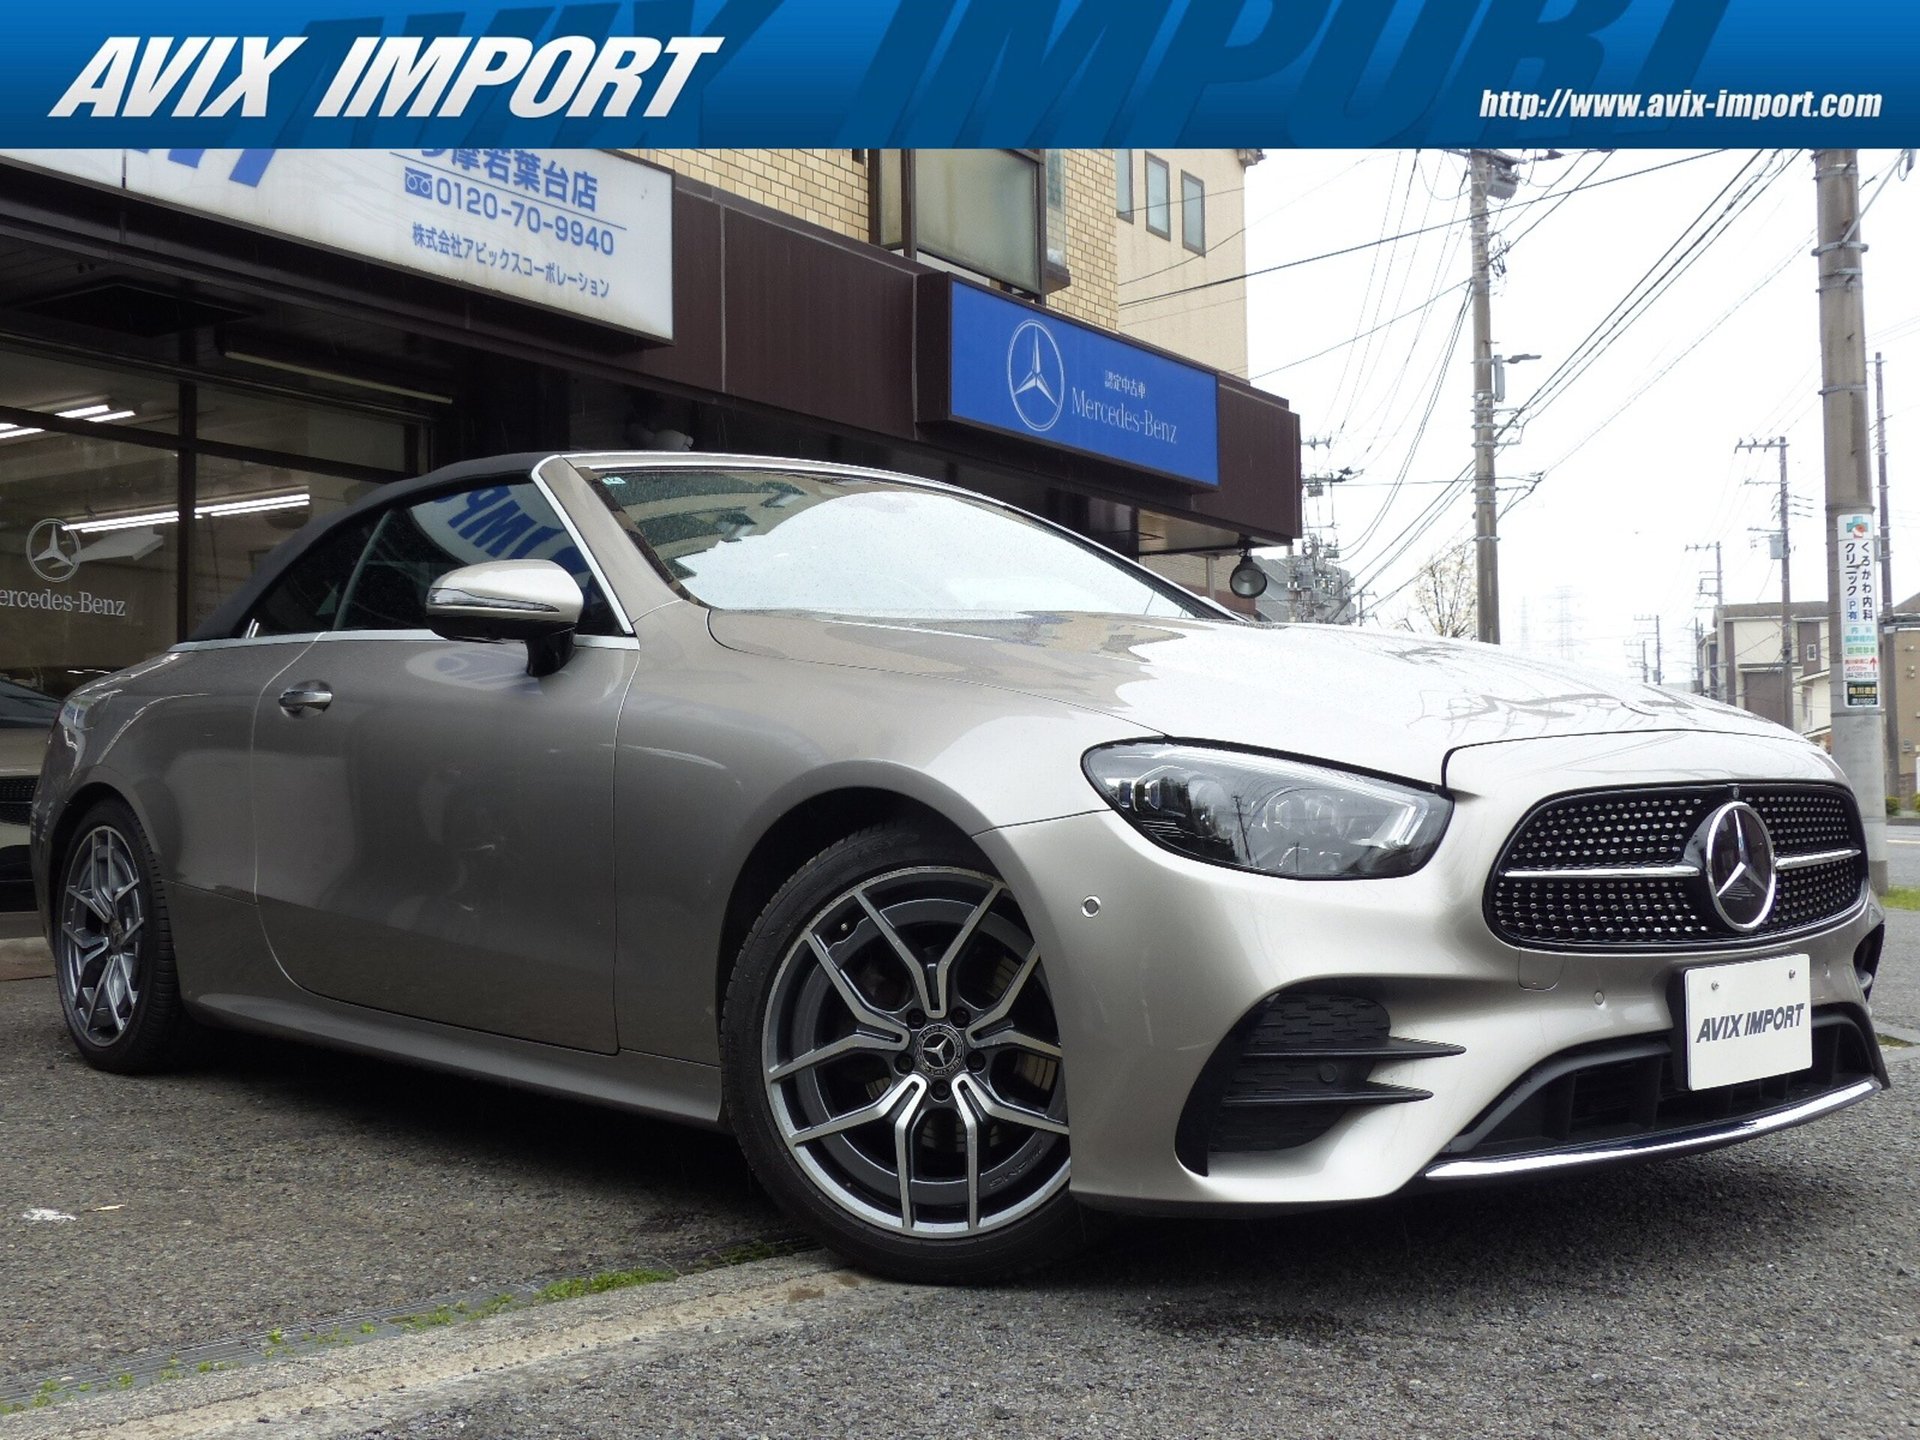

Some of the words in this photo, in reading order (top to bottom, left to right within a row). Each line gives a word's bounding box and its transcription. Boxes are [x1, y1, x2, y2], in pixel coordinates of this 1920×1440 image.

[437, 178, 614, 256] 0120-70-9940
[412, 221, 610, 298] 株式会社アビックスコーポレーション
[1105, 370, 1146, 399] 認定中古車
[1072, 387, 1177, 444] Mercedes-Benz
[1845, 543, 1857, 596] クリニック
[1861, 542, 1872, 621] くろかわ内科
[0, 589, 126, 616] ercedes-Benz
[1696, 1014, 1743, 1043] AVIX
[1744, 1003, 1805, 1036] IMPORT
